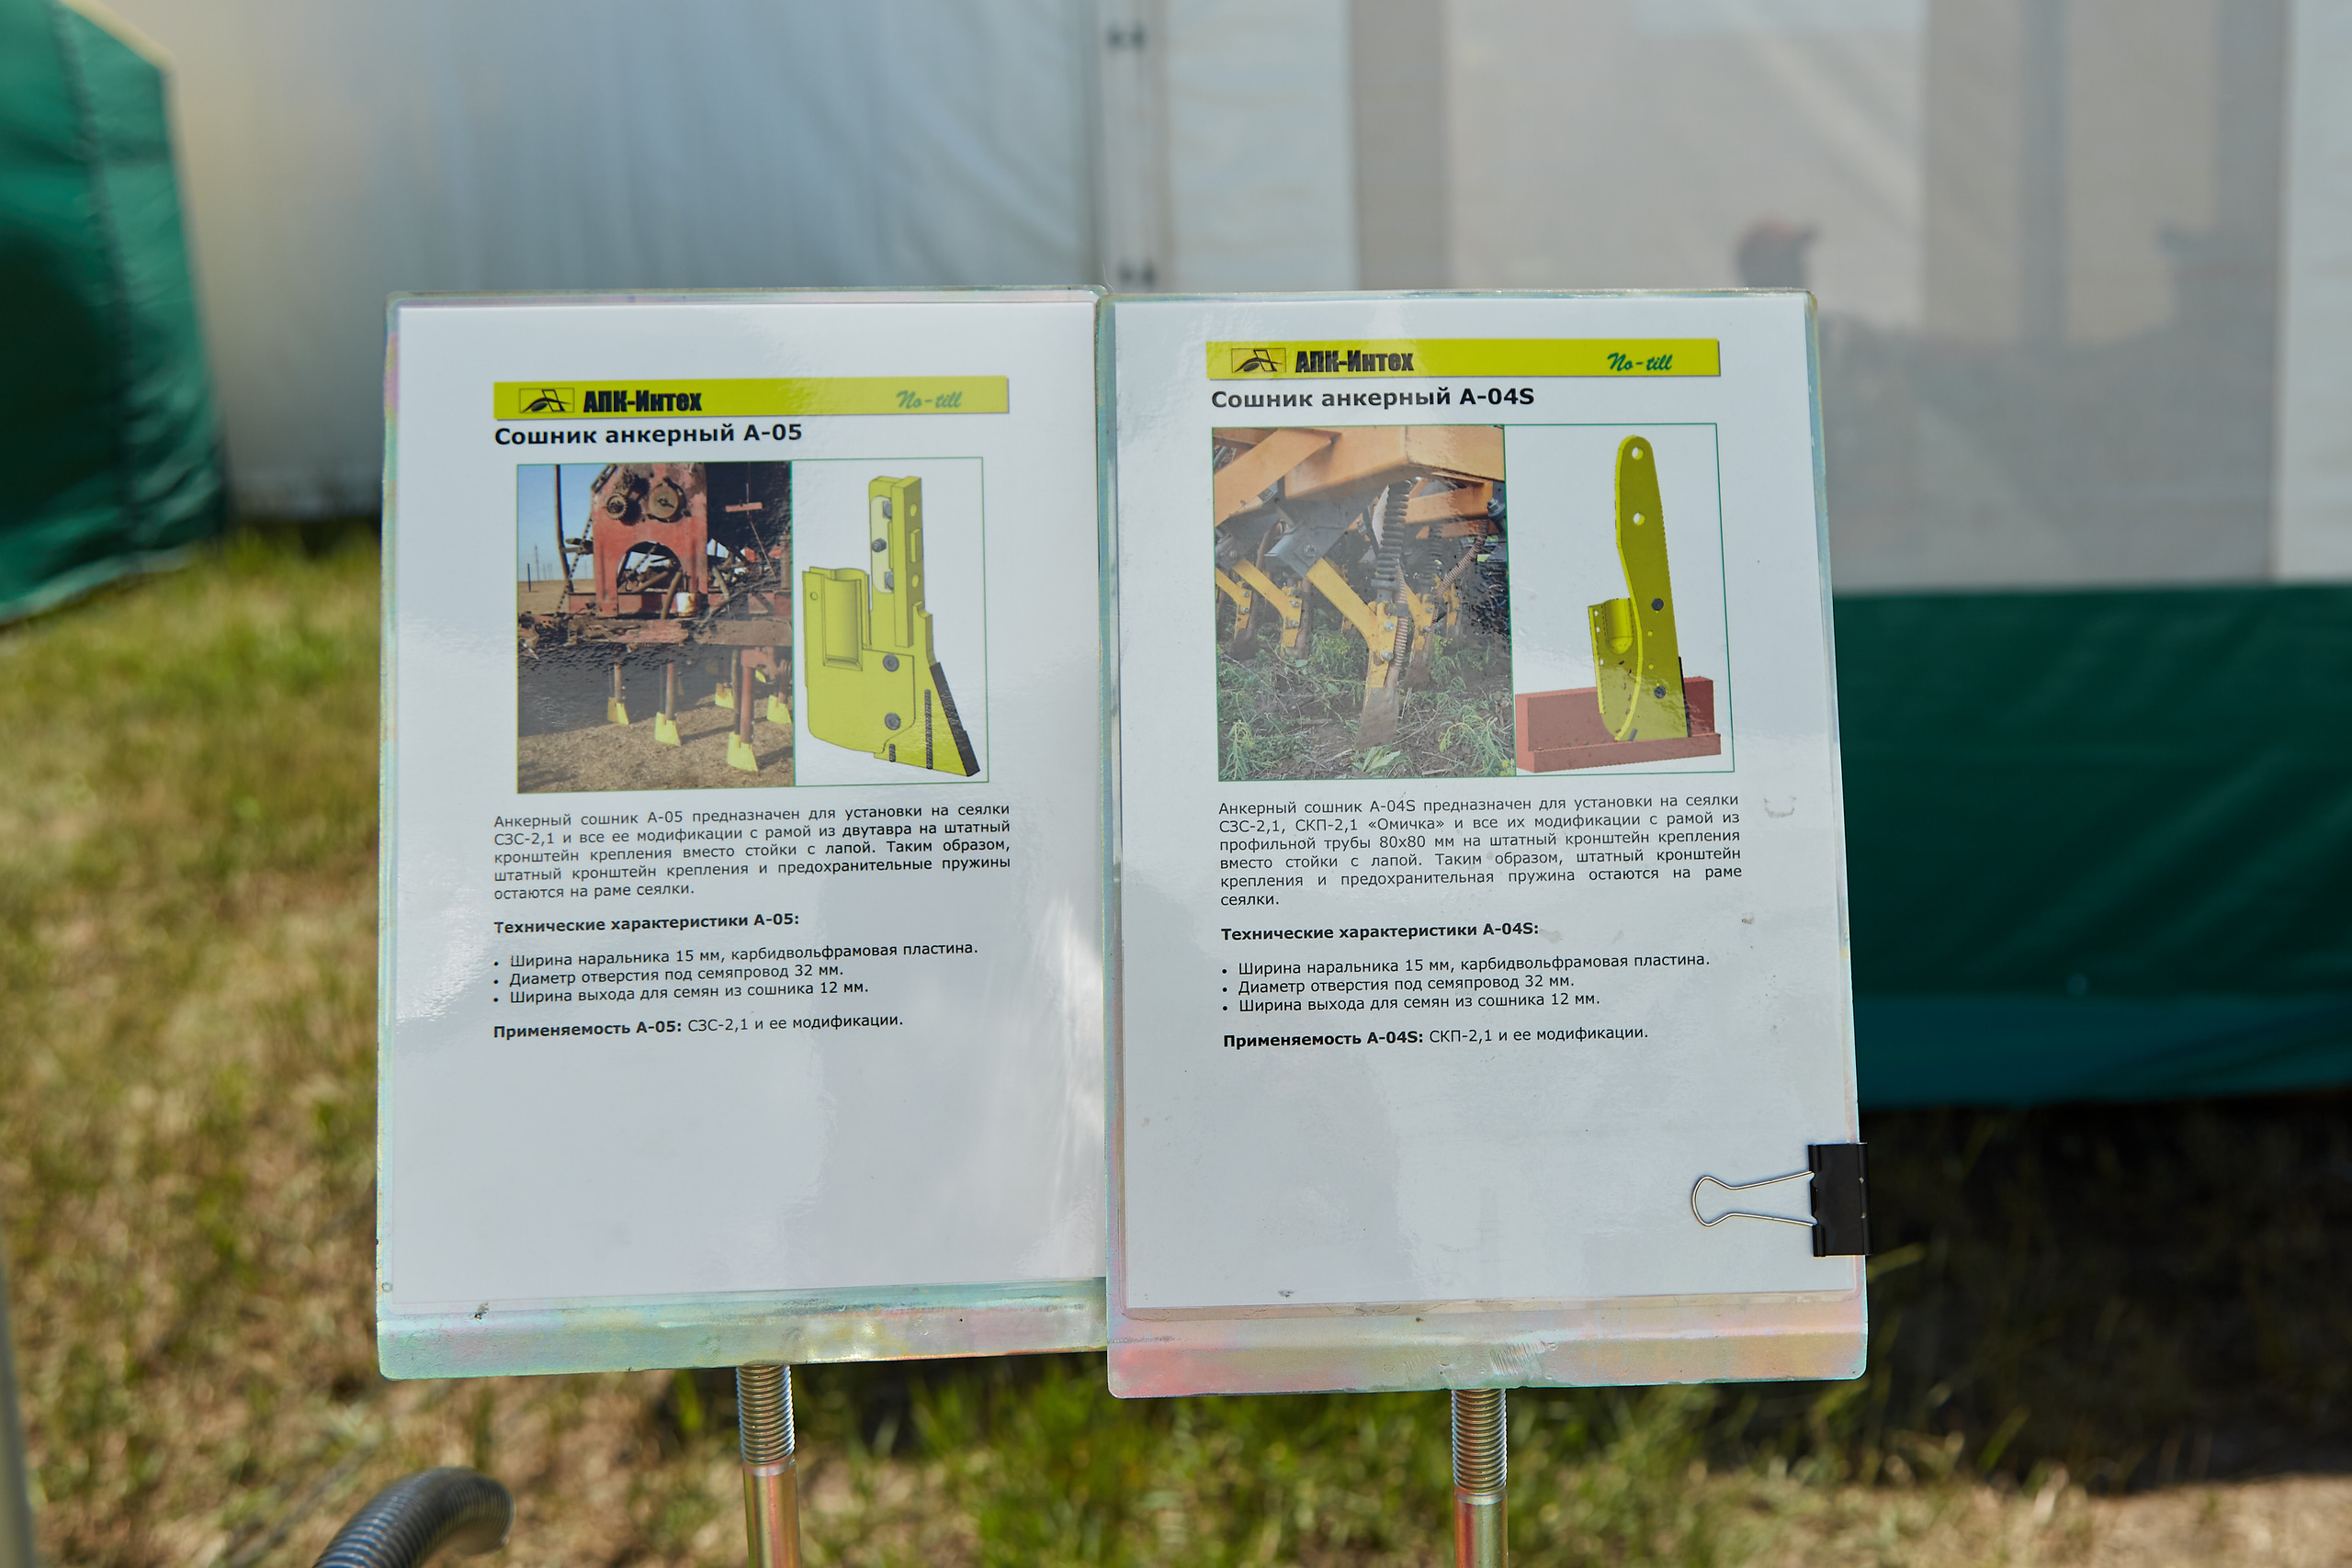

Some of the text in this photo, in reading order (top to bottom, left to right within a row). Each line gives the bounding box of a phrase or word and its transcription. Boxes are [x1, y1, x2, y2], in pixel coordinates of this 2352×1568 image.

[1295, 350, 1414, 373] АПК-Интех
[1607, 353, 1673, 371] No-till
[583, 390, 702, 412] АПК-Интех
[897, 389, 962, 409] No-till
[1212, 391, 1312, 407] Сошник
[1321, 387, 1450, 410] анкерный
[495, 428, 596, 445] Сошник
[605, 423, 733, 446] анкерный
[494, 814, 571, 829] Анкерный
[581, 815, 638, 825] сошник
[693, 810, 798, 824] предназначен
[808, 809, 835, 820] для
[844, 807, 922, 821] установки
[932, 807, 948, 816] на
[957, 805, 1009, 815] сеялки
[1218, 801, 1295, 817] Анкерный
[1305, 803, 1362, 813] сошник
[1424, 800, 1531, 814] предназначен
[1539, 799, 1566, 810] для
[1574, 797, 1652, 811] установки
[1660, 796, 1677, 806] на
[1686, 795, 1737, 806] сеялки
[494, 819, 1009, 846] СЗС-2,1 и все ее модификации с рамой из двутавра на штатный
[1219, 811, 1739, 834] СЗС-2,1, СКП-2,1 «Омичка» и все их модификации с рамой из
[495, 838, 1009, 865] кронштейн крепления вместо стойки с лапой. Таким образом,
[1220, 837, 1315, 852] профильной
[1324, 836, 1370, 852] трубы
[1435, 838, 1453, 847] мм
[1464, 837, 1480, 846] на
[1490, 832, 1555, 846] штатный
[1566, 830, 1648, 847] кронштейн
[1658, 831, 1739, 845] крепления
[1220, 847, 1740, 869] вместо стойки с лапой. Таким образом, штатный кронштейн
[494, 858, 1010, 881] штатный кронштейн крепления и предохранительные пружины
[1221, 867, 1741, 889] крепления и предохранительная пружина остаются на раме
[494, 885, 694, 899] остаются на раме сеялки.
[1221, 896, 1278, 906] сеялки.
[493, 920, 605, 933] Технические
[611, 917, 747, 931] характеристики
[1221, 928, 1333, 940] Технические
[1339, 926, 1476, 941] характеристики
[511, 943, 977, 968] Ширина наральника 15 мм, карбидвольфрамовая пластина.
[1239, 955, 1709, 977] Ширина наральника 15 мм, карбидвольфрамовая пластина.
[509, 964, 842, 987] Диаметр отверстия под семяпровод 32 мм.
[1238, 975, 1573, 996] Диаметр отверстия под семяпровод 32 мм.
[511, 981, 867, 1005] Ширина выхода для семян из сошника 12 мм.
[1239, 992, 1599, 1014] Ширина выхода для семян из сошника 12 мм.
[494, 1024, 630, 1040] Применяемость
[688, 1018, 747, 1032] СЗС-2,1
[755, 1021, 763, 1029] и
[769, 1020, 786, 1029] ее
[793, 1014, 902, 1030] модификации.
[1224, 1034, 1361, 1050] Применяемость
[1430, 1029, 1491, 1043] СКП-2,1
[1498, 1032, 1507, 1041] и
[1513, 1031, 1531, 1040] ее
[1537, 1026, 1647, 1042] модификации.
